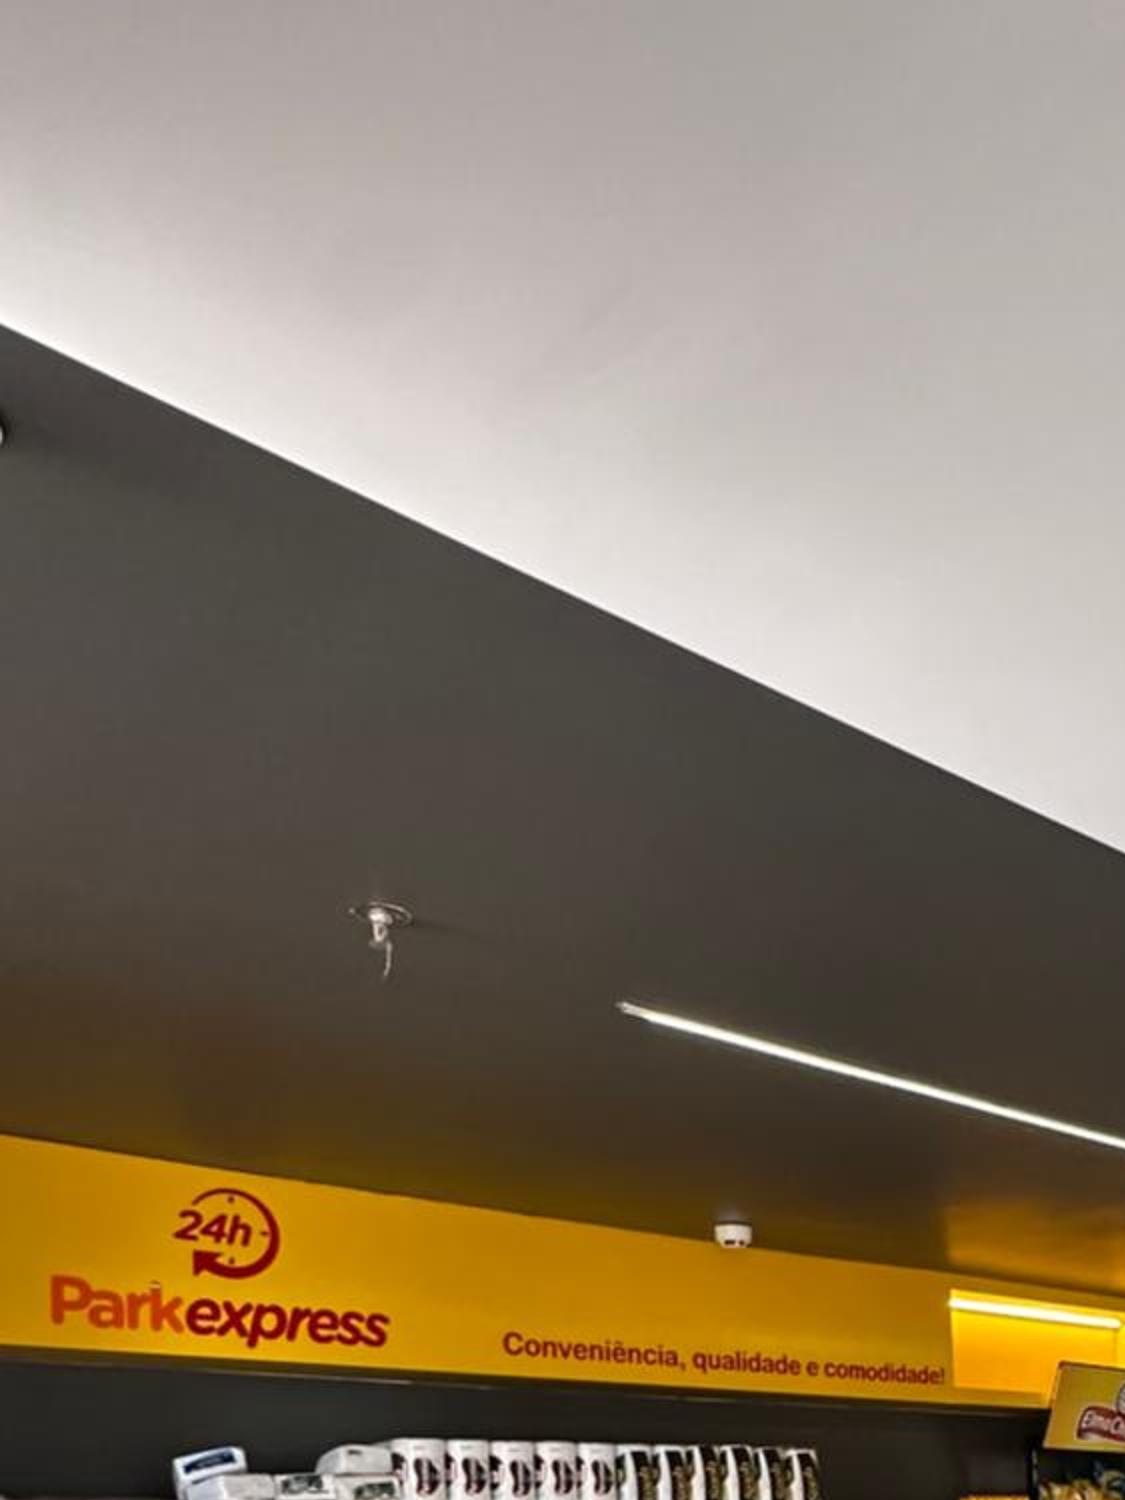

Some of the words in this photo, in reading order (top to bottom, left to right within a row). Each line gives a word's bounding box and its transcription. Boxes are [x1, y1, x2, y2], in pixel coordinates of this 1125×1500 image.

[173, 1209, 252, 1247] 24h
[50, 1274, 391, 1349] Parkexpress
[502, 1330, 687, 1371] Conveniência,
[692, 1349, 801, 1377] qualidade
[806, 1361, 818, 1377] e
[823, 1361, 946, 1385] comodidade!
